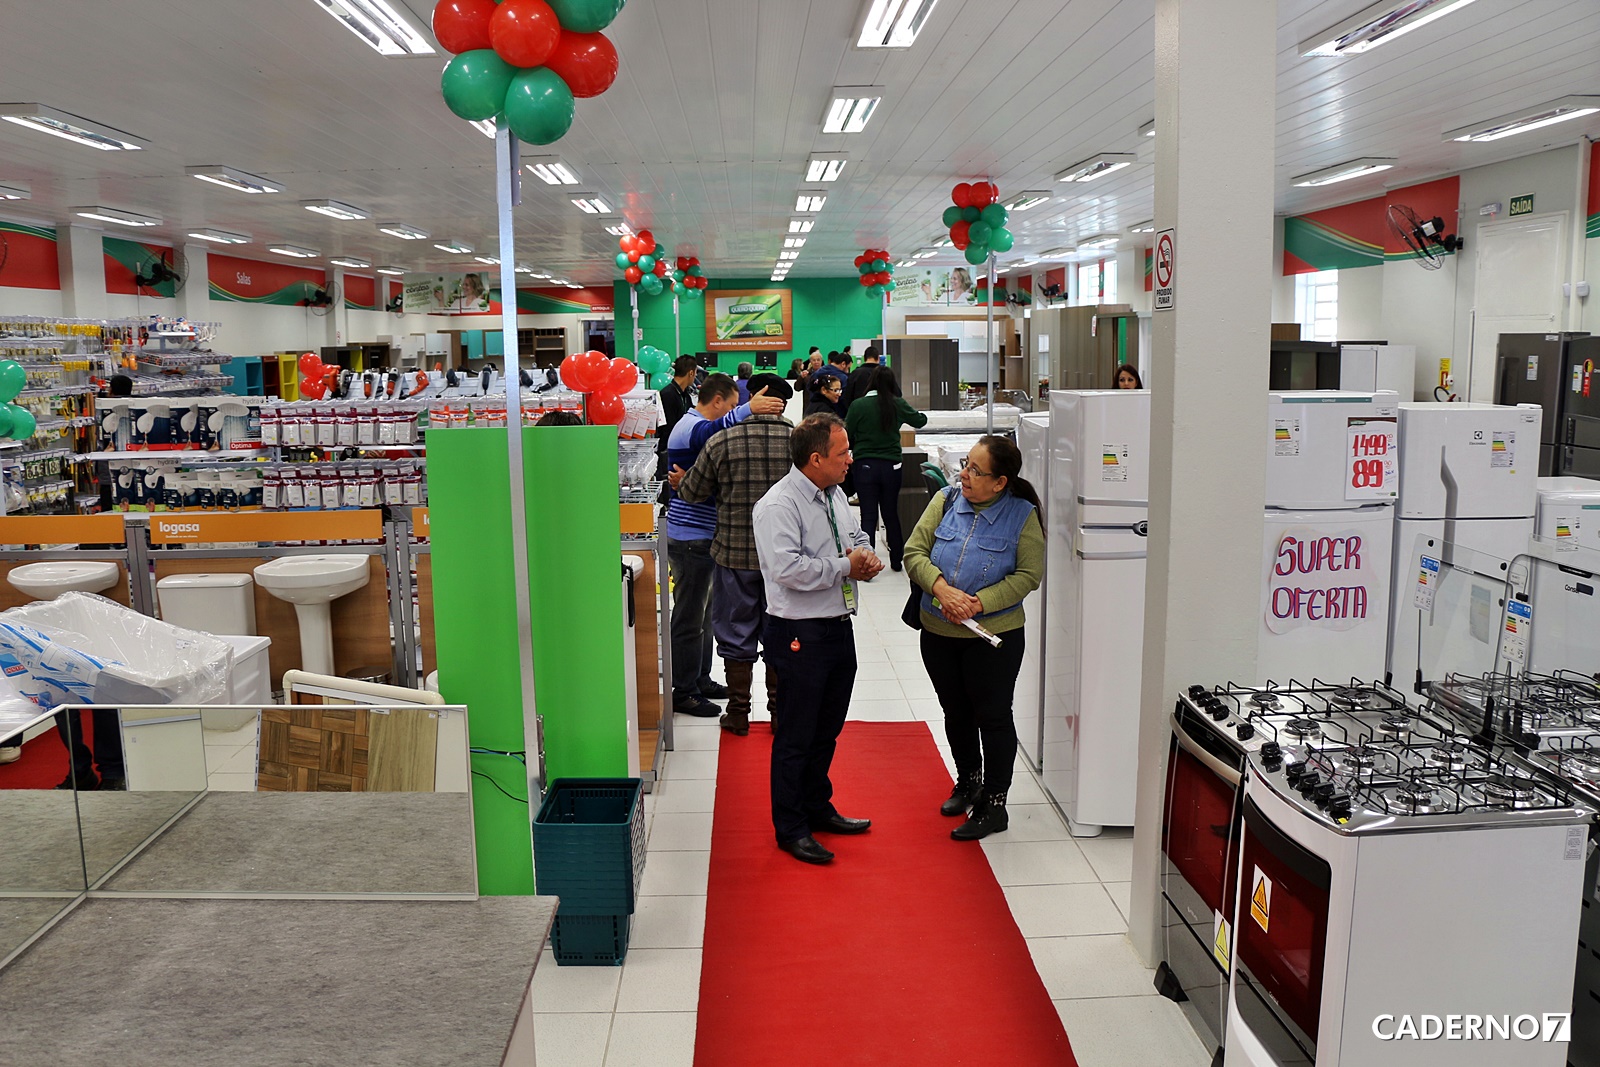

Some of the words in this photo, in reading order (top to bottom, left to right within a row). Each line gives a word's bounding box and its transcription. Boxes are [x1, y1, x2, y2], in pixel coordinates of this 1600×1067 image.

[1511, 198, 1532, 215] SAÍDA
[236, 271, 252, 286] Salas
[1156, 287, 1172, 296] PROIBIDO
[1158, 296, 1170, 305] FUMAR
[242, 398, 260, 406] hydra
[231, 442, 252, 450] Optima
[158, 459, 174, 467] hydra
[159, 521, 200, 534] logasa
[1275, 536, 1362, 576] SUPER
[1272, 586, 1367, 620] OFERTA
